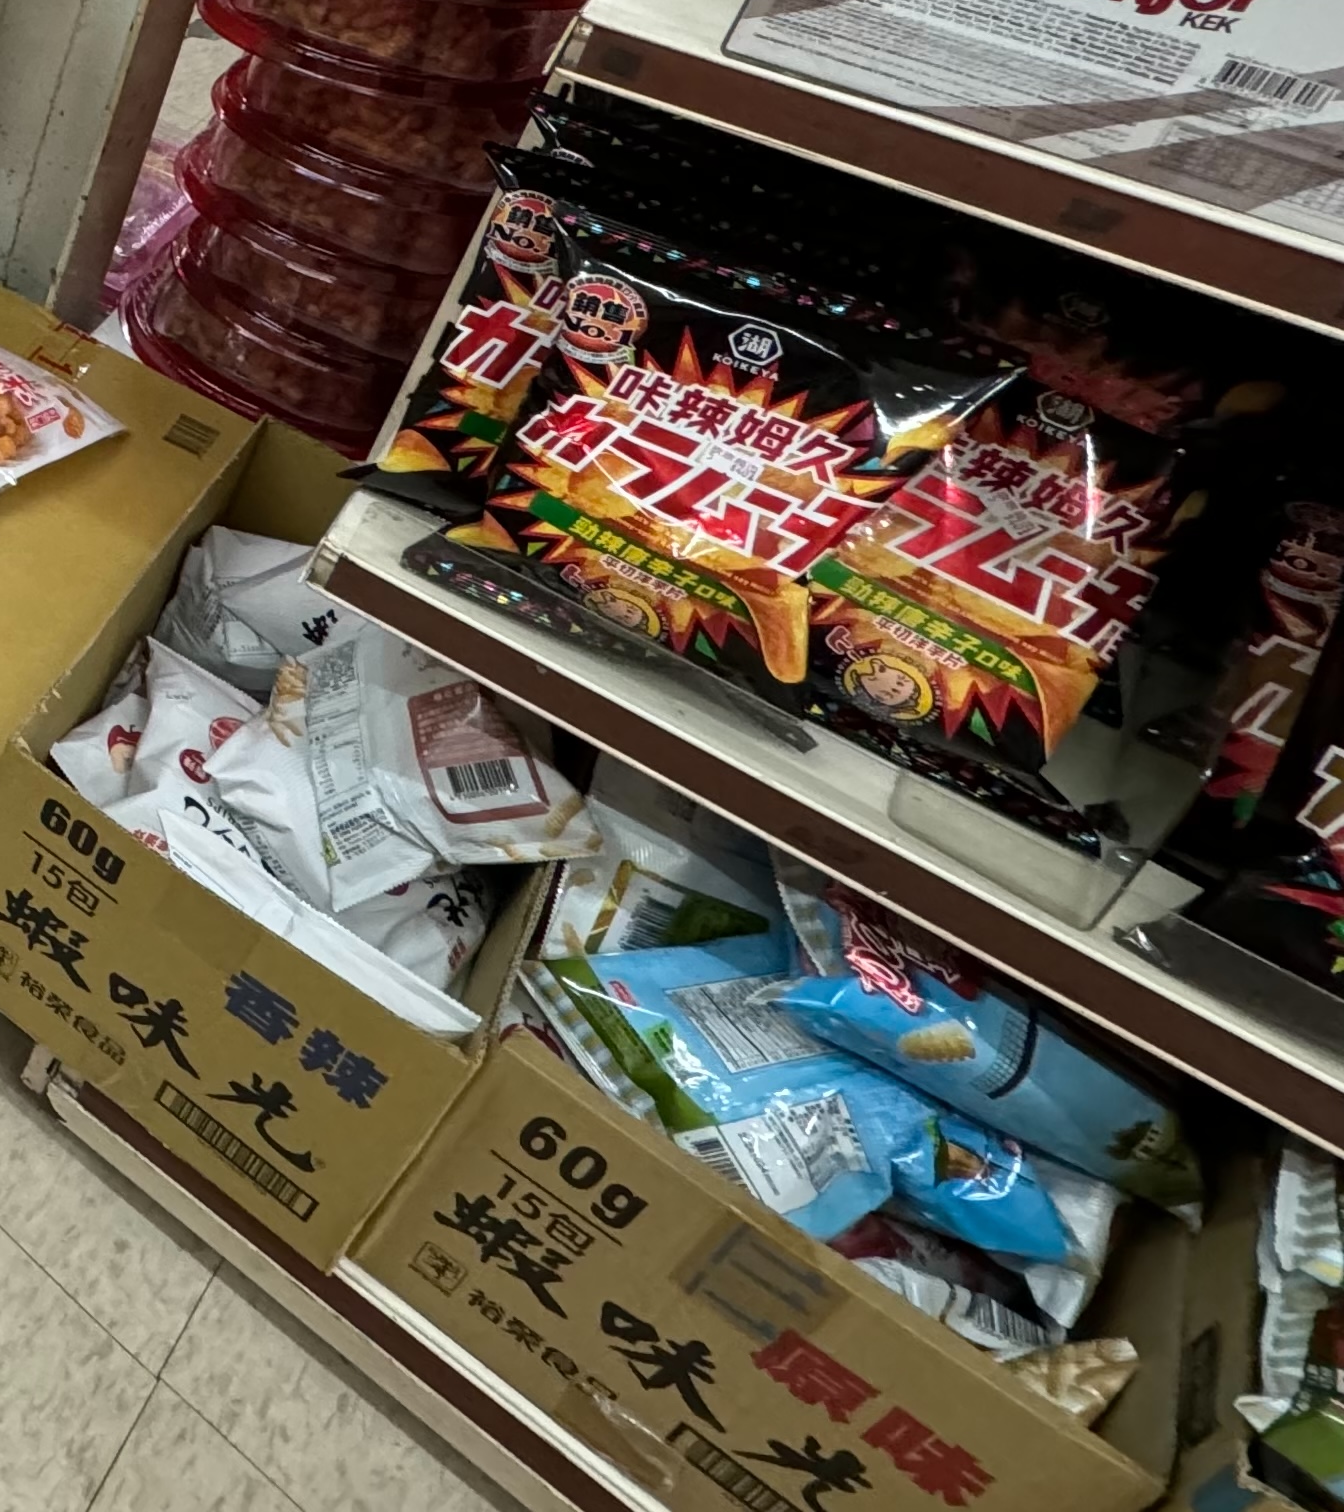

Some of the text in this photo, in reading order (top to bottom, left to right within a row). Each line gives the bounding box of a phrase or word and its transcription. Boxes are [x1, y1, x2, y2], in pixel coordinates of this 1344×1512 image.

[1179, 10, 1241, 35] KEK
[571, 291, 631, 325] 銷售
[739, 330, 772, 360] 湖
[712, 351, 780, 382] KOIKEYA
[1016, 413, 1088, 447] KOIKEYA
[39, 797, 127, 886] 60g
[27, 849, 101, 917] 15包
[19, 971, 128, 1068] 裕榮食品
[223, 969, 392, 1110] 香辣
[518, 1115, 650, 1231] 60g
[496, 1174, 597, 1258] 15包
[749, 1327, 997, 1508] 原味
